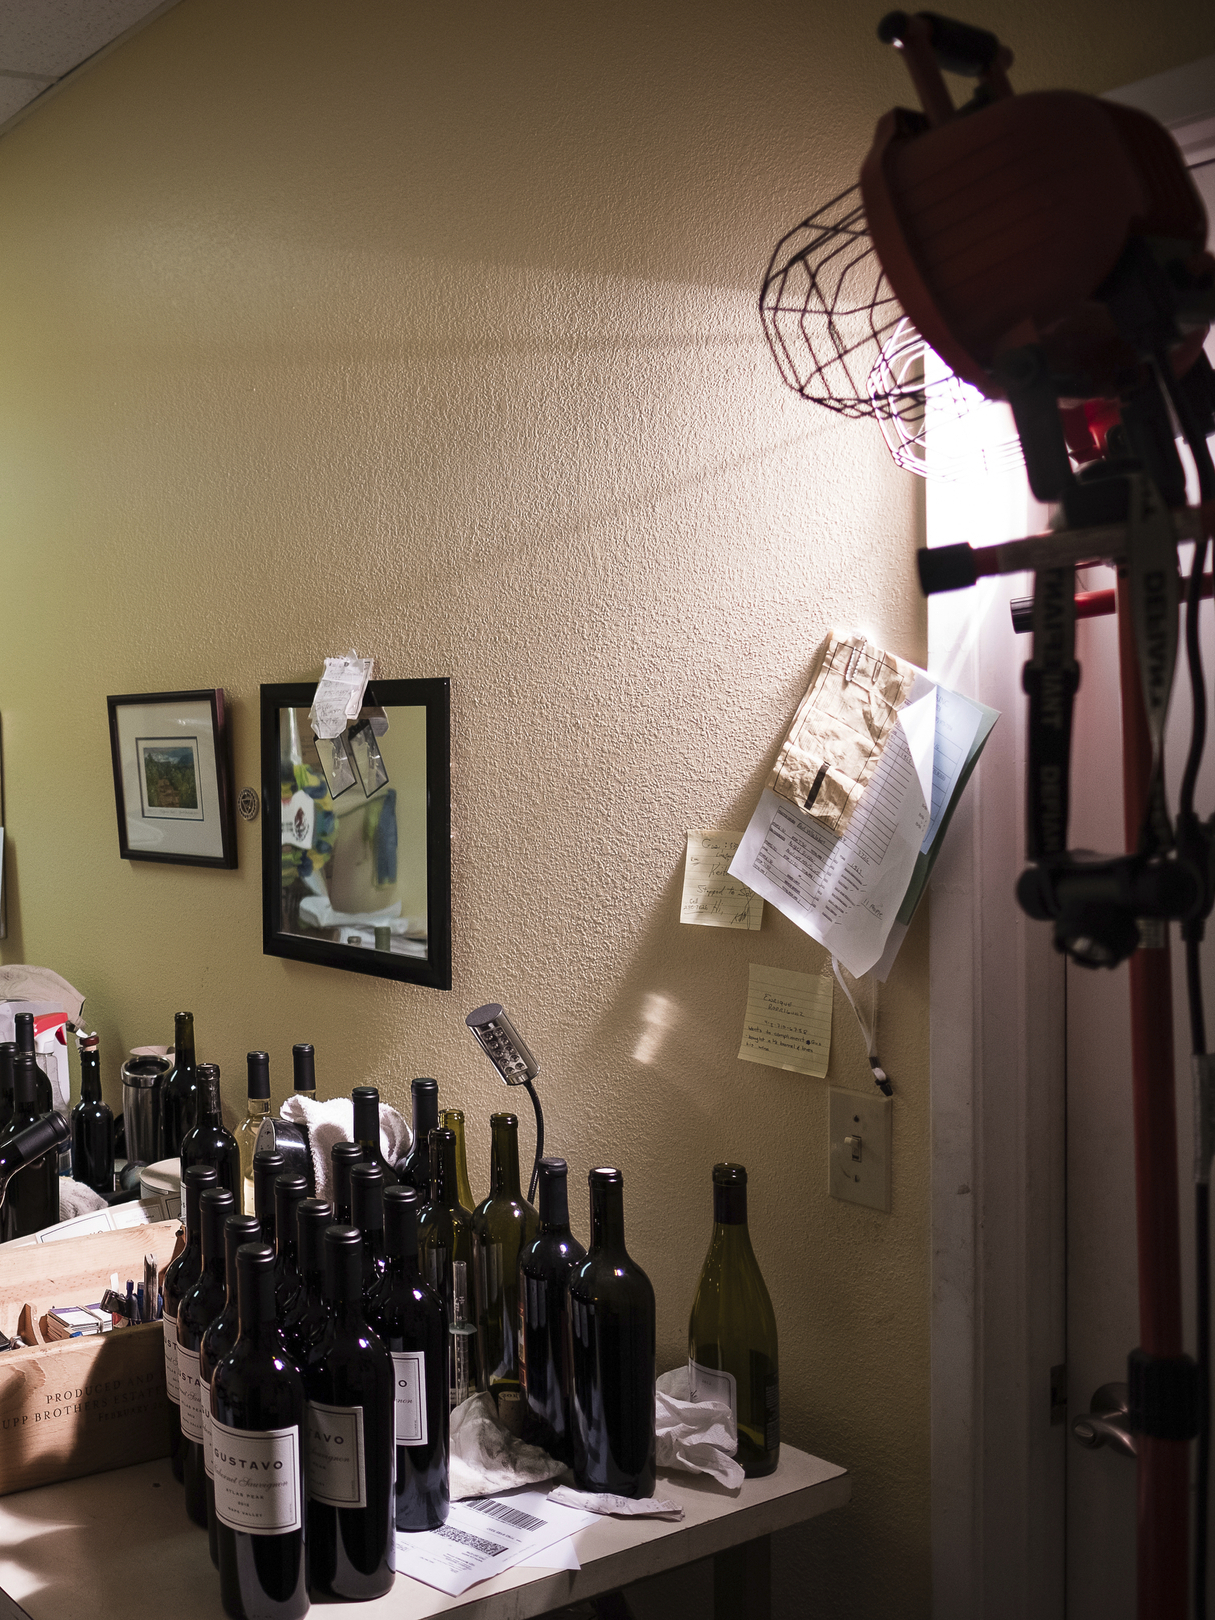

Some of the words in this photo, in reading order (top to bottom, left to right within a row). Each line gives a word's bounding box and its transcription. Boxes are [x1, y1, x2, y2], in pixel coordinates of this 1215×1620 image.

[46, 1380, 121, 1404] PRODUCED
[128, 1372, 155, 1388] AND
[34, 1399, 108, 1422] BROTHERS
[98, 1404, 148, 1422] FEBRUARY
[214, 1447, 283, 1471] GUSTAVO
[226, 1488, 243, 1497] ATLAS
[238, 1476, 288, 1492] Sauvignon
